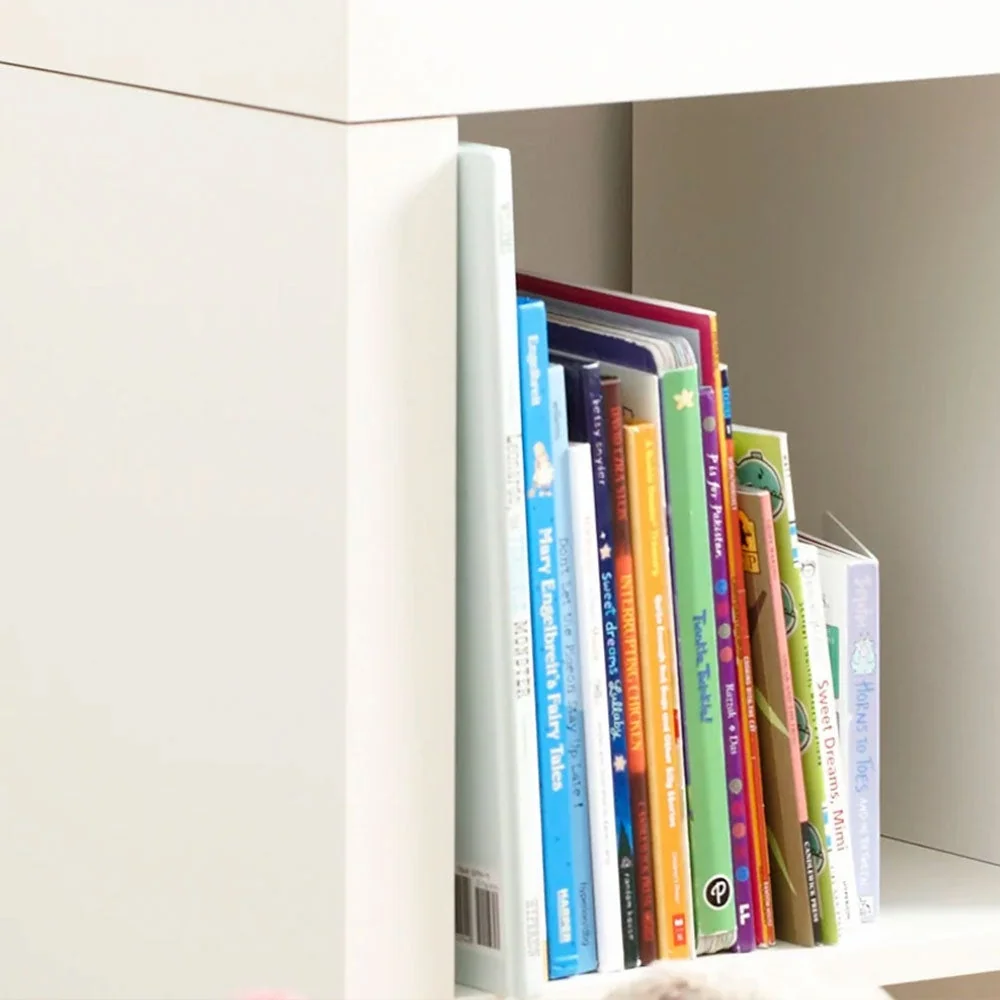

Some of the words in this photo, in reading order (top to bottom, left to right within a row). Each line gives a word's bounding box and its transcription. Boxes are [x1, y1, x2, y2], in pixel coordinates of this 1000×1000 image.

[706, 453, 718, 463] P
[708, 466, 719, 477] is
[706, 481, 720, 499] for
[538, 527, 555, 574] Mary
[709, 503, 724, 559] Pakistan
[540, 578, 561, 689] Engelbreit's
[620, 573, 640, 683] INTERRUPTING
[546, 692, 563, 739] Fairy
[609, 679, 625, 741] Lullaby
[627, 685, 643, 751] CHICKEN
[817, 679, 834, 732] Sweet
[549, 743, 565, 792] Tales
[728, 735, 739, 755] Das
[823, 736, 840, 804] Dreams,
[832, 809, 848, 852] Mimi
[804, 841, 816, 896] CANDLEWICK
[626, 911, 635, 941] house
[809, 898, 820, 923] PRESS
